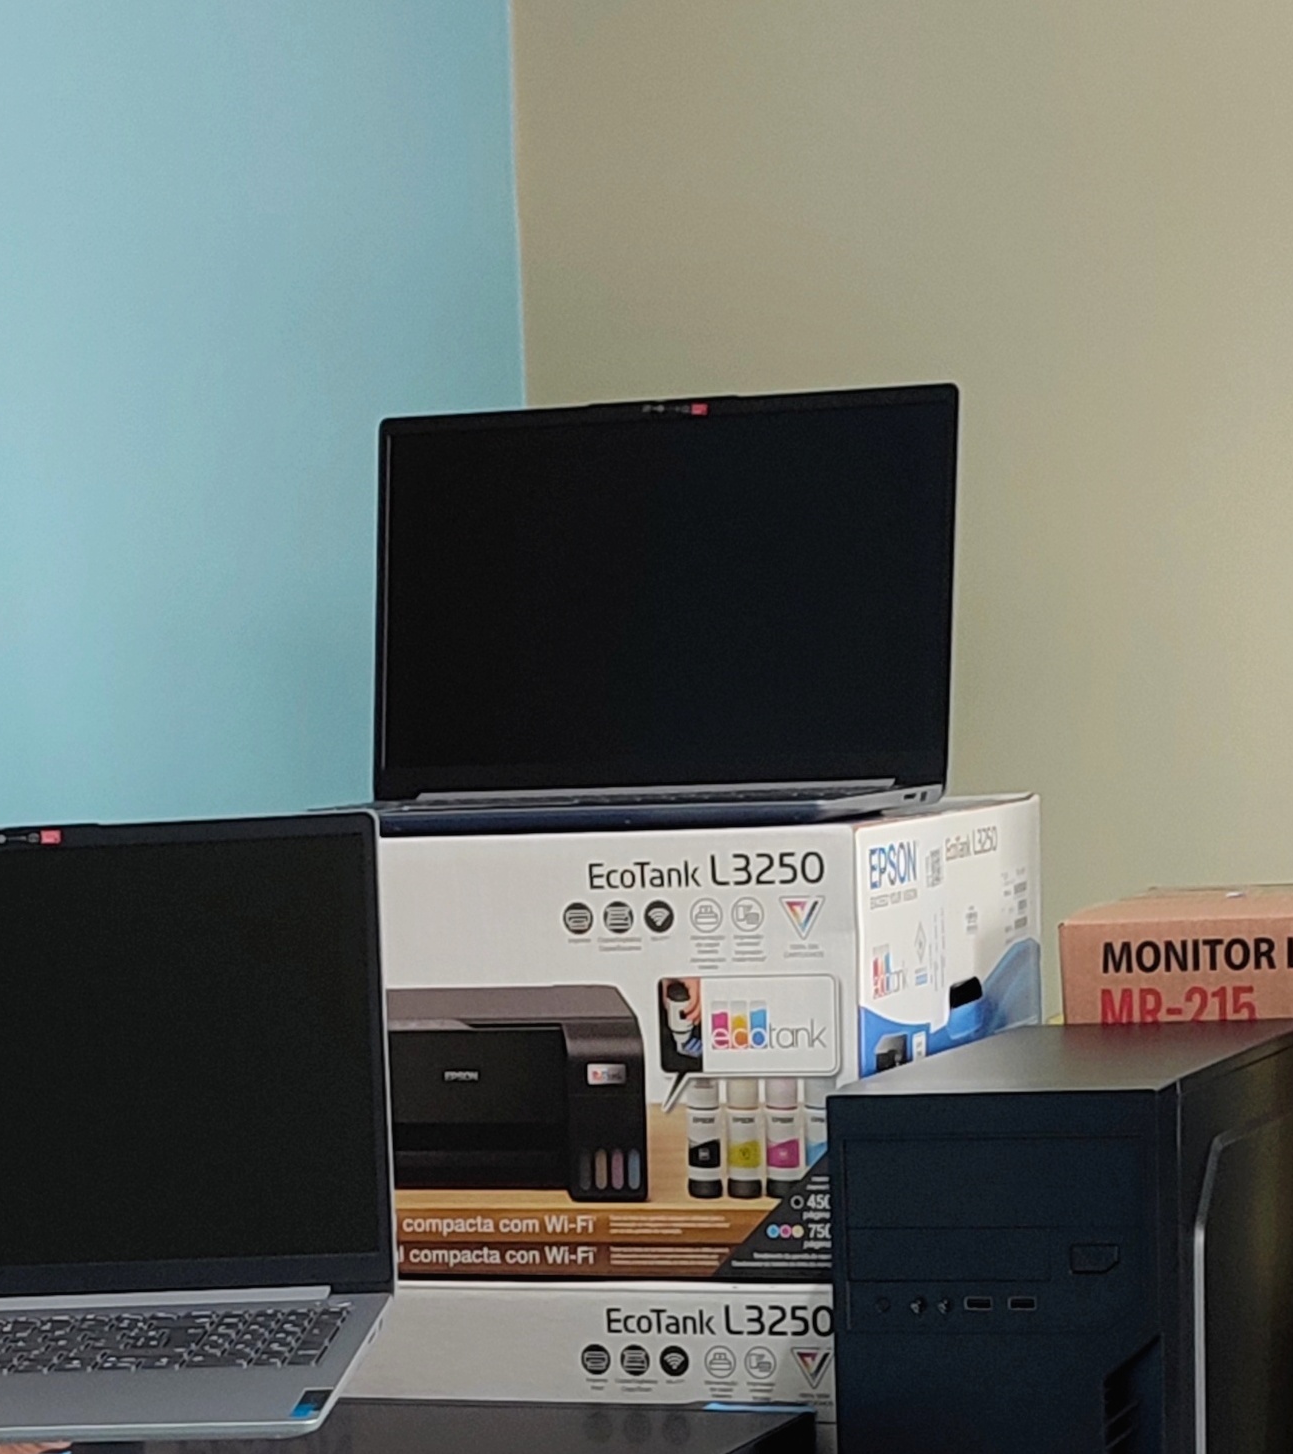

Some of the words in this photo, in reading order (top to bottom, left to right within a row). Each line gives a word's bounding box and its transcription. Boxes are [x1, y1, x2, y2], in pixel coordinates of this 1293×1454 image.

[587, 860, 703, 890] EcoTank
[709, 851, 826, 886] L3250
[868, 839, 918, 890] EPSON
[1101, 936, 1276, 975] MONITOR
[1099, 984, 1257, 1026] MR-215
[711, 1018, 827, 1050] ecotank
[402, 1215, 495, 1237] compacta
[499, 1217, 540, 1233] com
[544, 1214, 595, 1234] Wi-Fi
[409, 1246, 502, 1268] compacta
[505, 1249, 540, 1264] con
[544, 1245, 595, 1265] Wi-Fi
[605, 1307, 717, 1336] EcoTank
[723, 1304, 835, 1337] L3250
